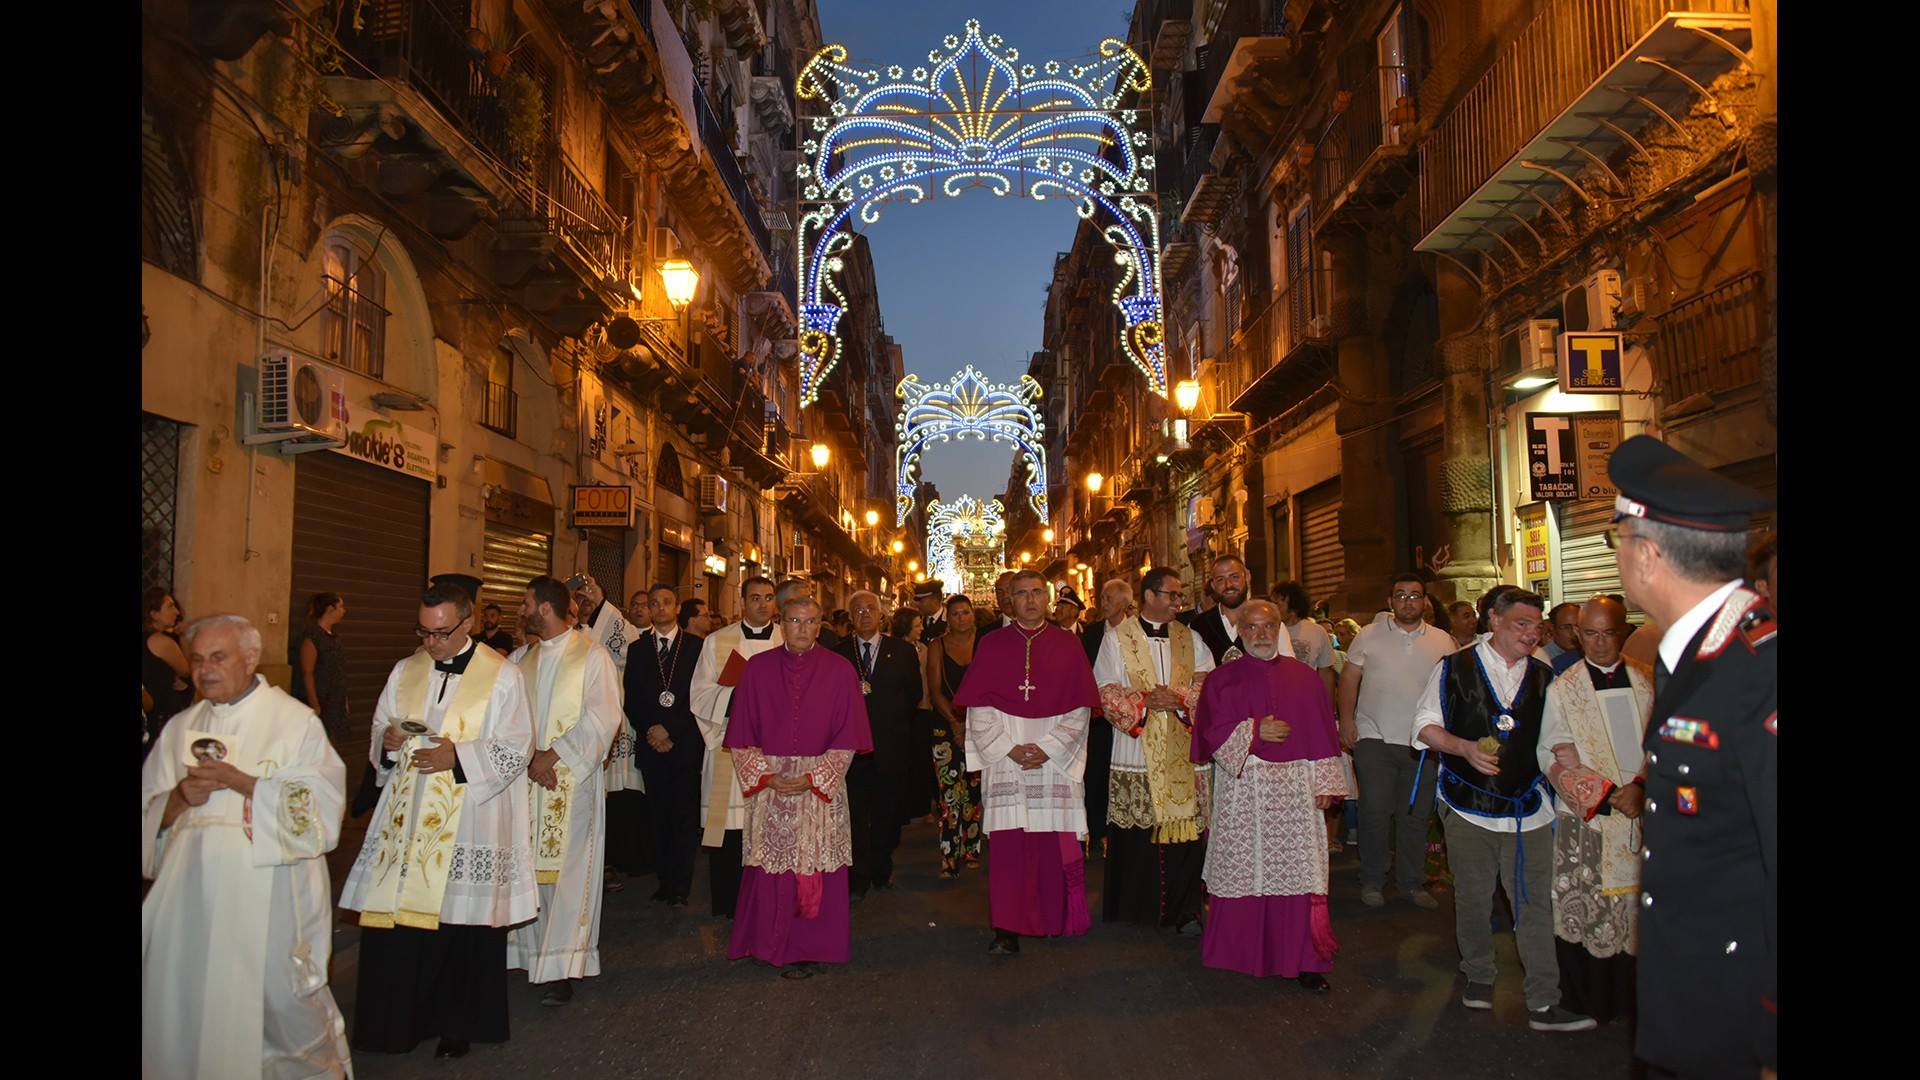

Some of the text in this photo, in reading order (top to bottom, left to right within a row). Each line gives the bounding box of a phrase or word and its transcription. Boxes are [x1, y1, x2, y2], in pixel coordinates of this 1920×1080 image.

[1572, 338, 1615, 385] T
[1582, 369, 1607, 378] SELF
[1574, 377, 1616, 386] SERVICE
[1533, 417, 1569, 474] T
[1538, 483, 1574, 491] TABACCHI
[576, 489, 627, 510] FOTO
[1530, 530, 1540, 543] SELF
[1526, 544, 1546, 558] SERVICE
